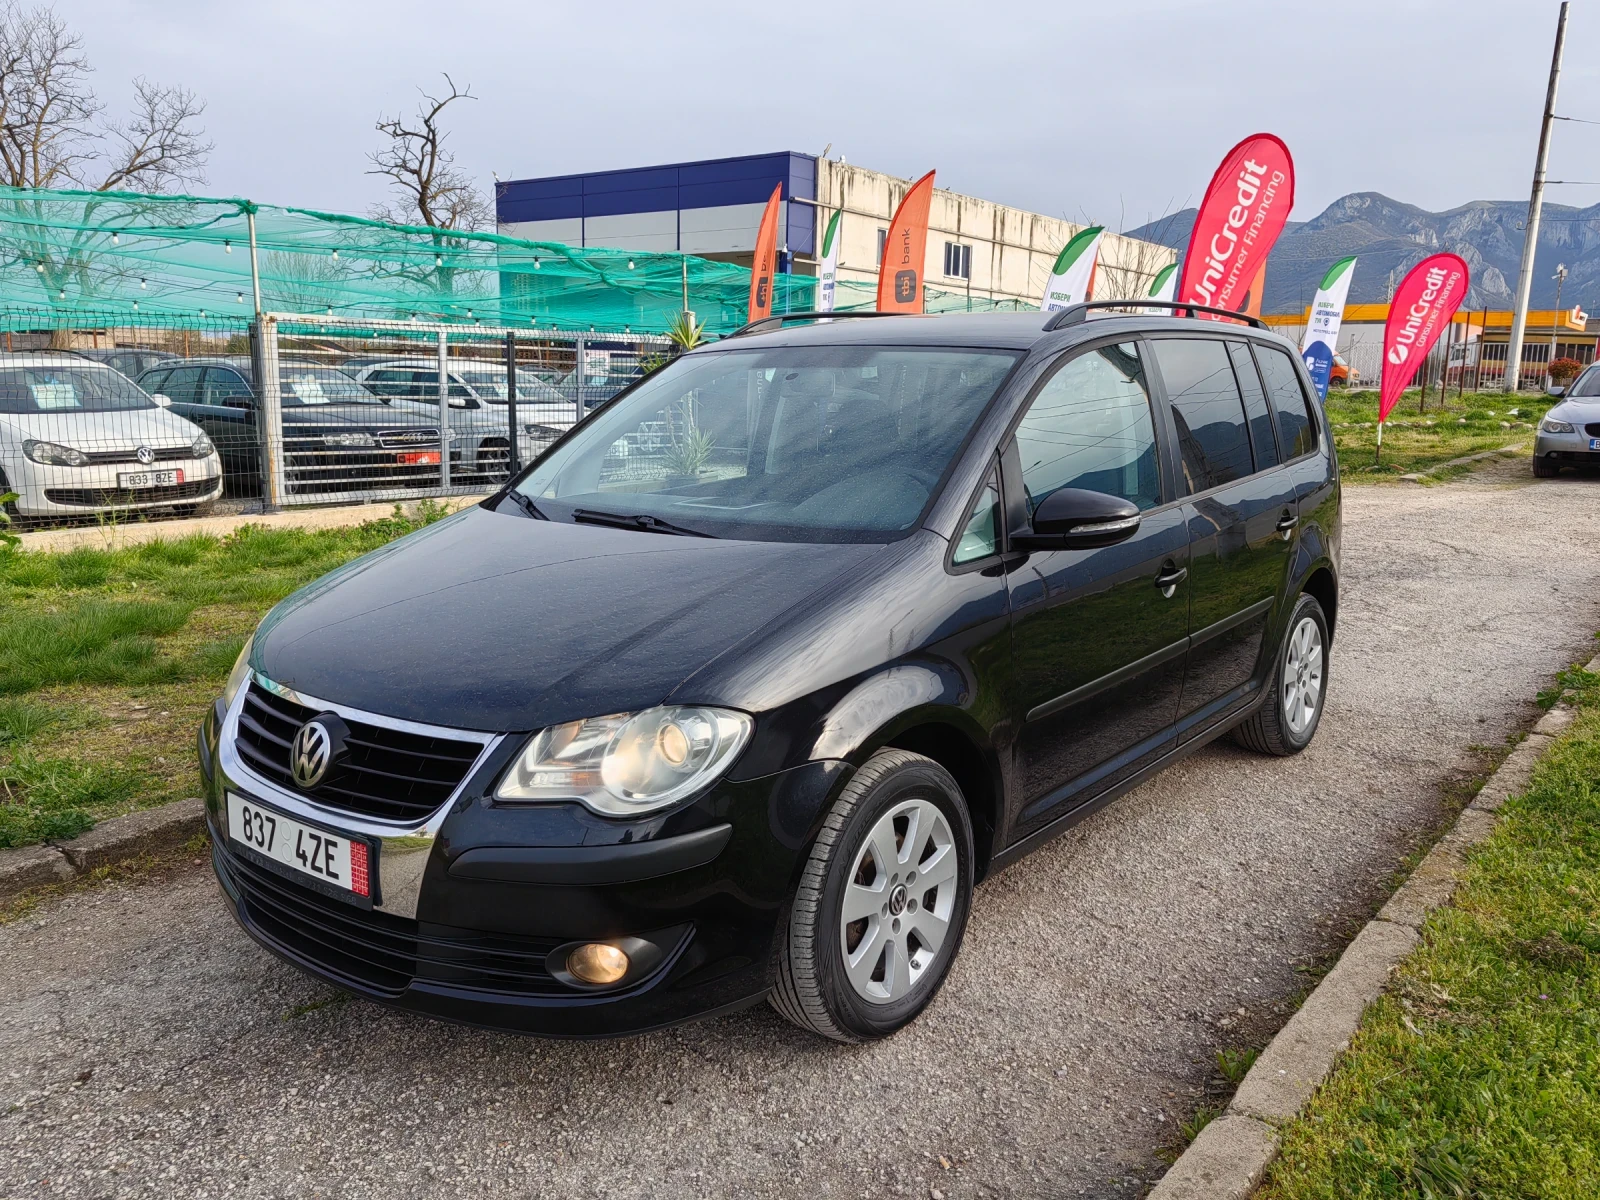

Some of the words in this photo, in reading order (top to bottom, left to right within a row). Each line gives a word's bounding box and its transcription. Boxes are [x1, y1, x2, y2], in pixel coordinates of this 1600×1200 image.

[1243, 170, 1285, 246] Financing
[901, 228, 911, 264] bank
[901, 276, 910, 297] tbi
[1050, 291, 1072, 301] ИЗБЕРИ
[1397, 267, 1448, 344] UniCredit
[1416, 308, 1440, 347] Consumer
[1434, 271, 1462, 309] Financing
[129, 474, 148, 485] 833
[156, 472, 173, 483] 8ZE
[242, 805, 277, 852] 837
[295, 828, 340, 880] 4ZE
